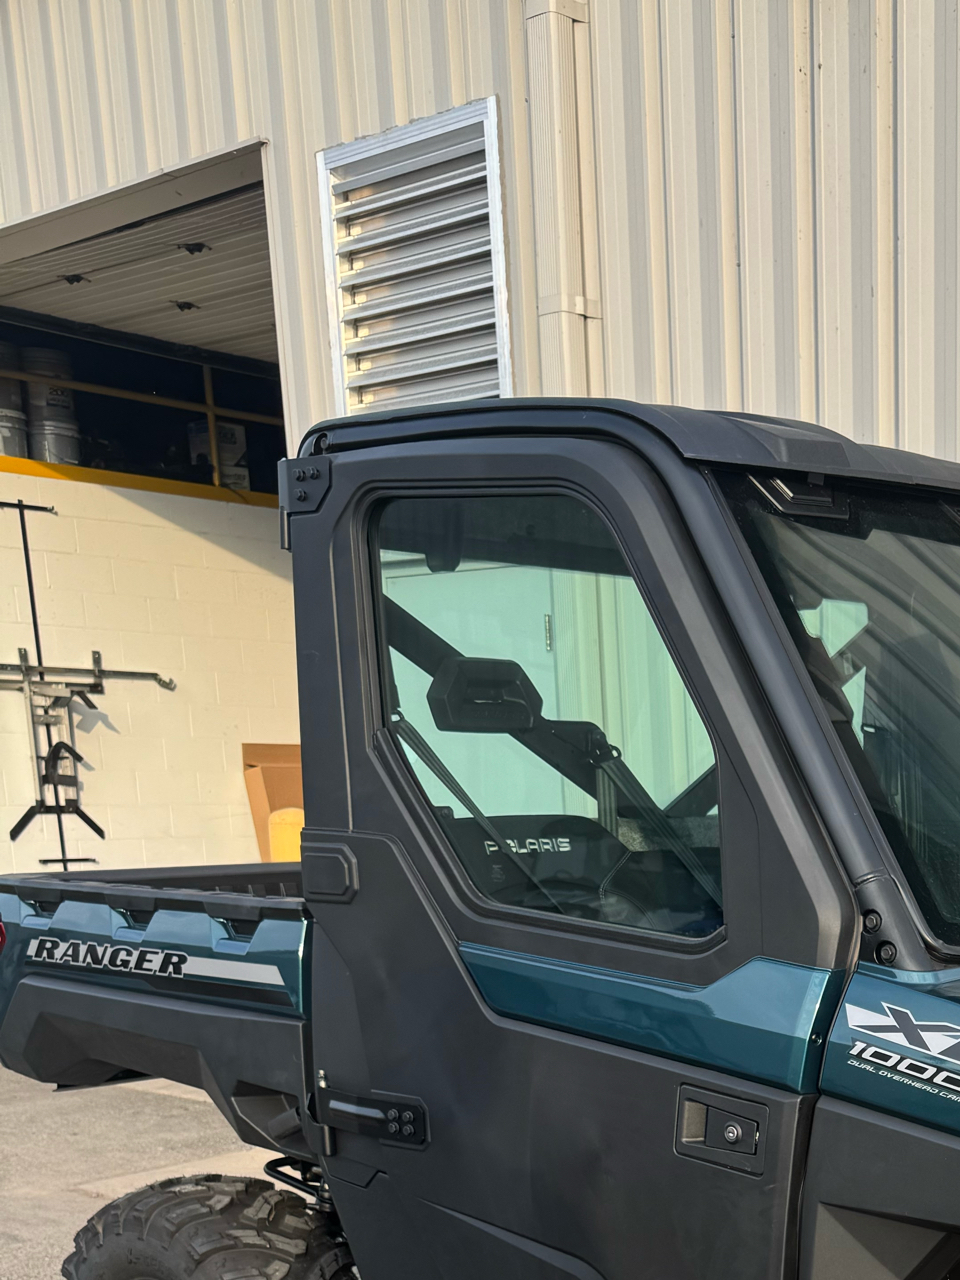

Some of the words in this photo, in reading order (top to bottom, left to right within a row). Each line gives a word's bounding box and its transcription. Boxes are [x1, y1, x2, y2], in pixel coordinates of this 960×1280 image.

[33, 936, 188, 978] RANGER
[847, 1058, 877, 1075] DUAL
[878, 1068, 939, 1094] OVERHEAD
